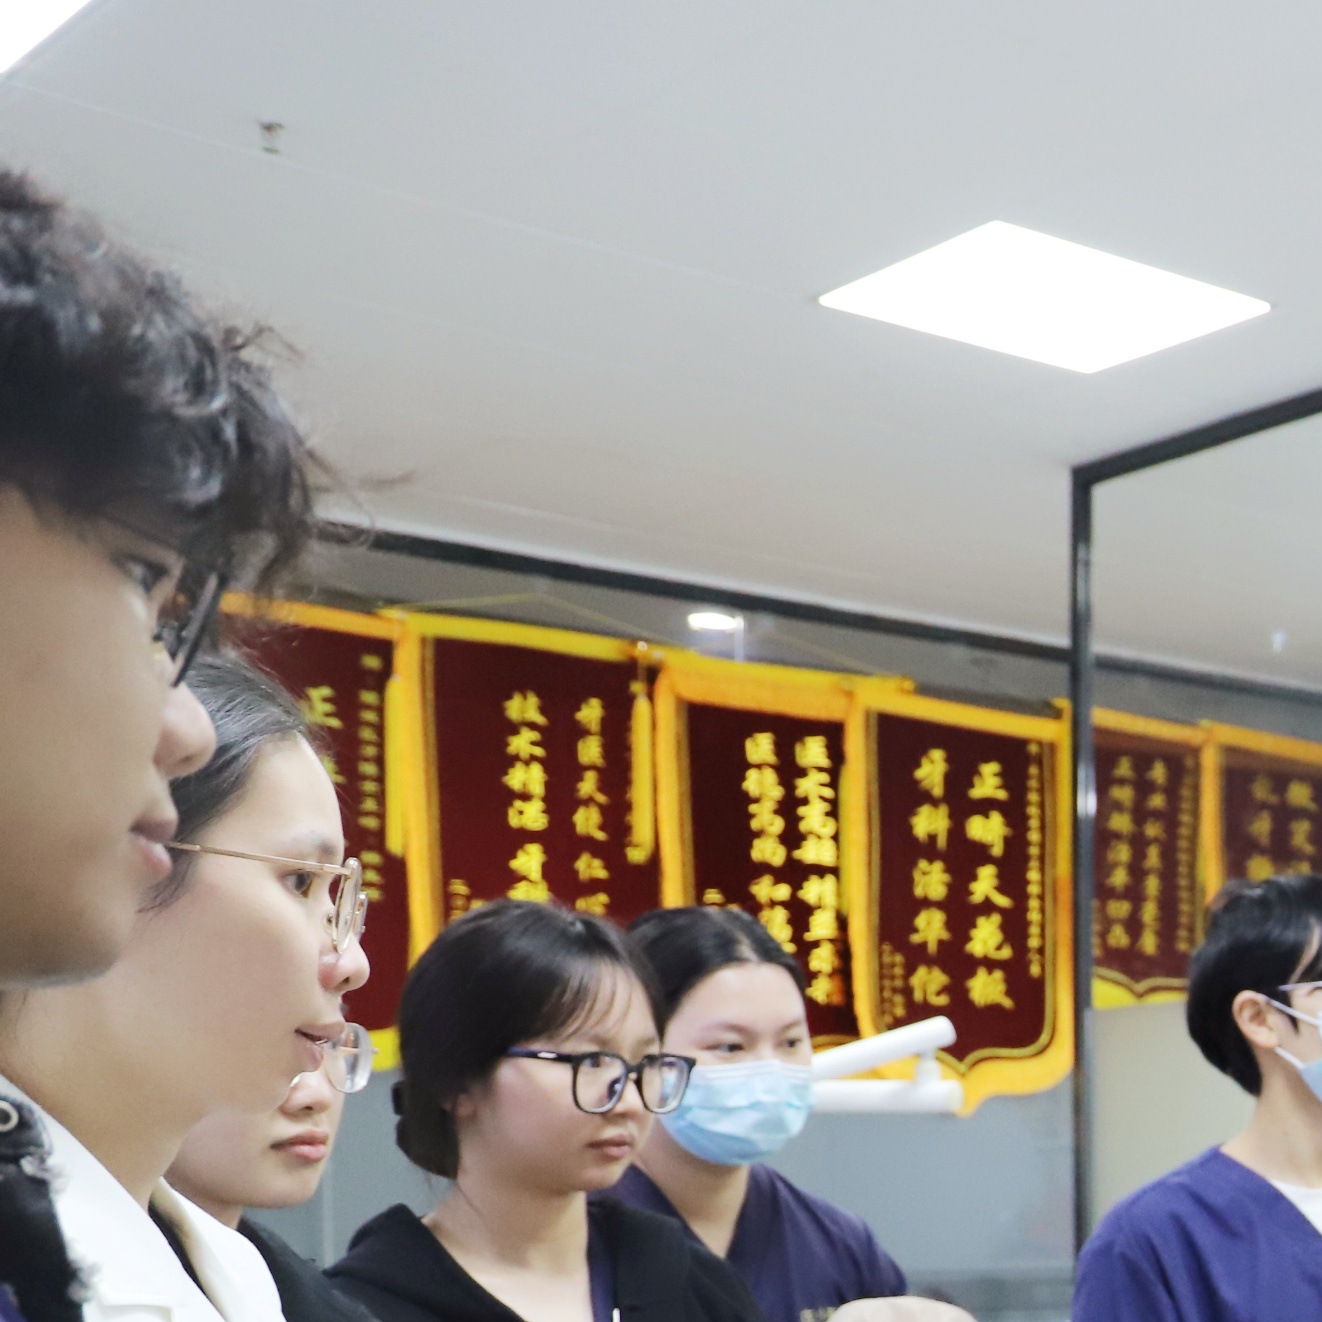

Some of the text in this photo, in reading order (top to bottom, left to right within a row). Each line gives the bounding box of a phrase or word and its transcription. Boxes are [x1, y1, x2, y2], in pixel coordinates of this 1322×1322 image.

[909, 747, 951, 1007] 牙科活华佗
[964, 760, 1014, 1009] 正畸天花板
